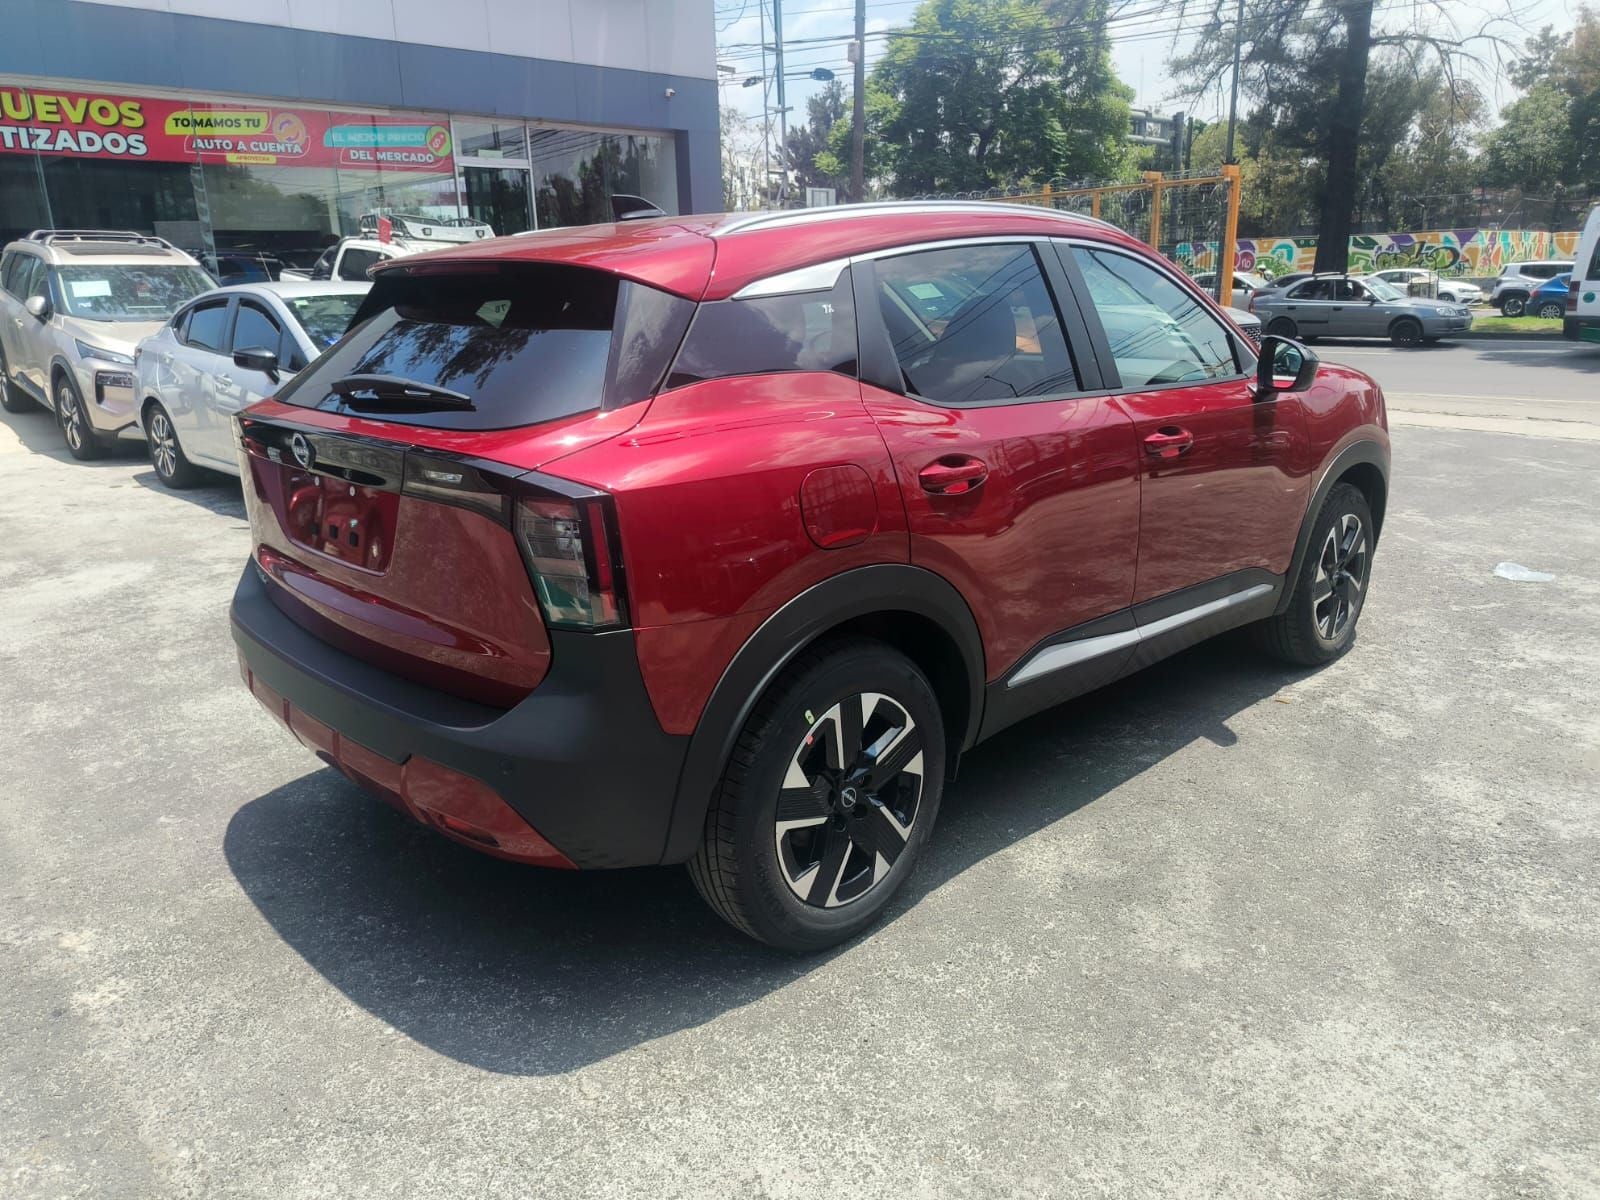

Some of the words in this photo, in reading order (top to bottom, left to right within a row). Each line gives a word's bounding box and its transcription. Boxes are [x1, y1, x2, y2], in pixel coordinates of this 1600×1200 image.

[0, 91, 145, 128] UEVOS
[172, 117, 242, 128] TOMAMOS
[243, 118, 260, 128] TU
[0, 126, 148, 155] TIZADOS
[192, 139, 233, 150] AUTO
[237, 141, 247, 151] A
[250, 141, 303, 153] CUENTA
[350, 150, 374, 160] DEL
[376, 151, 435, 163] MERCADO
